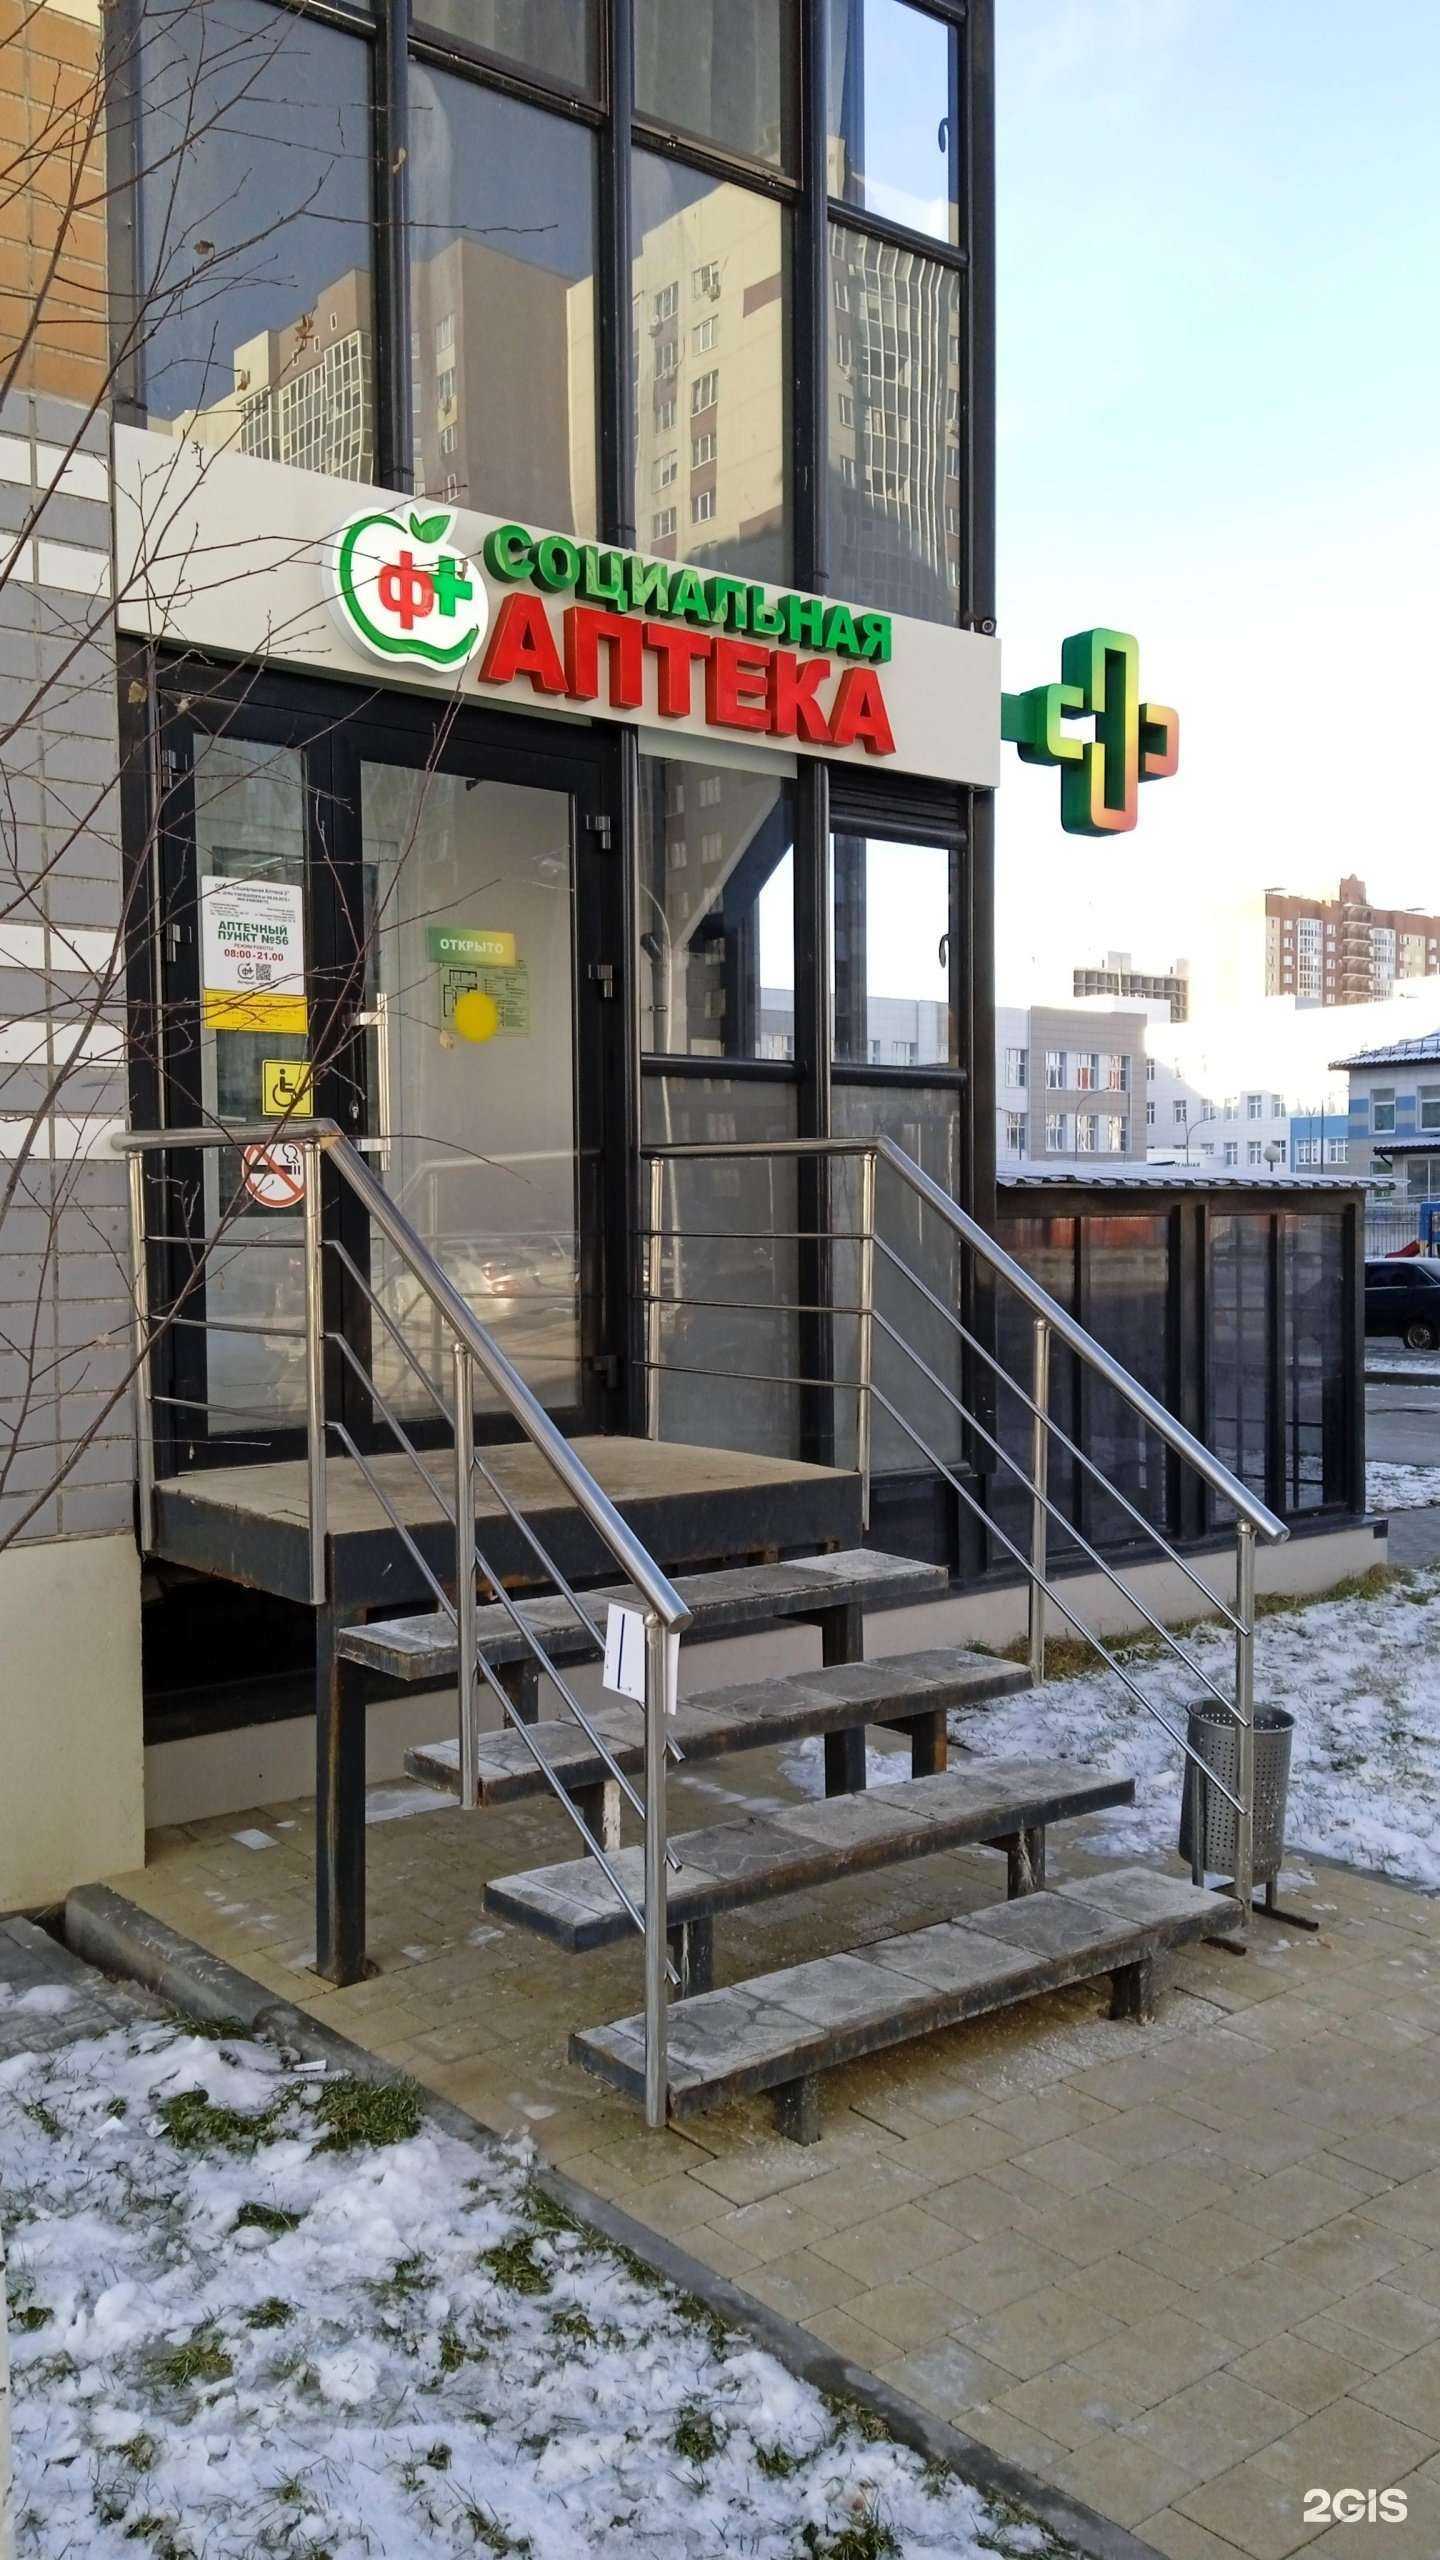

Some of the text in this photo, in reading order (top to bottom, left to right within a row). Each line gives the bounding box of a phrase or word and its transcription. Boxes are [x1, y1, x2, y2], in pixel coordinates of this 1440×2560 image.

[483, 525, 893, 664] СОЦИАЛЬНАЯ
[479, 592, 897, 757] АПТЕКА
[218, 921, 288, 935] АПТЕЧНЫЙ
[218, 930, 289, 946] ПУНКТ №56
[440, 938, 504, 954] ОТКРЫТО
